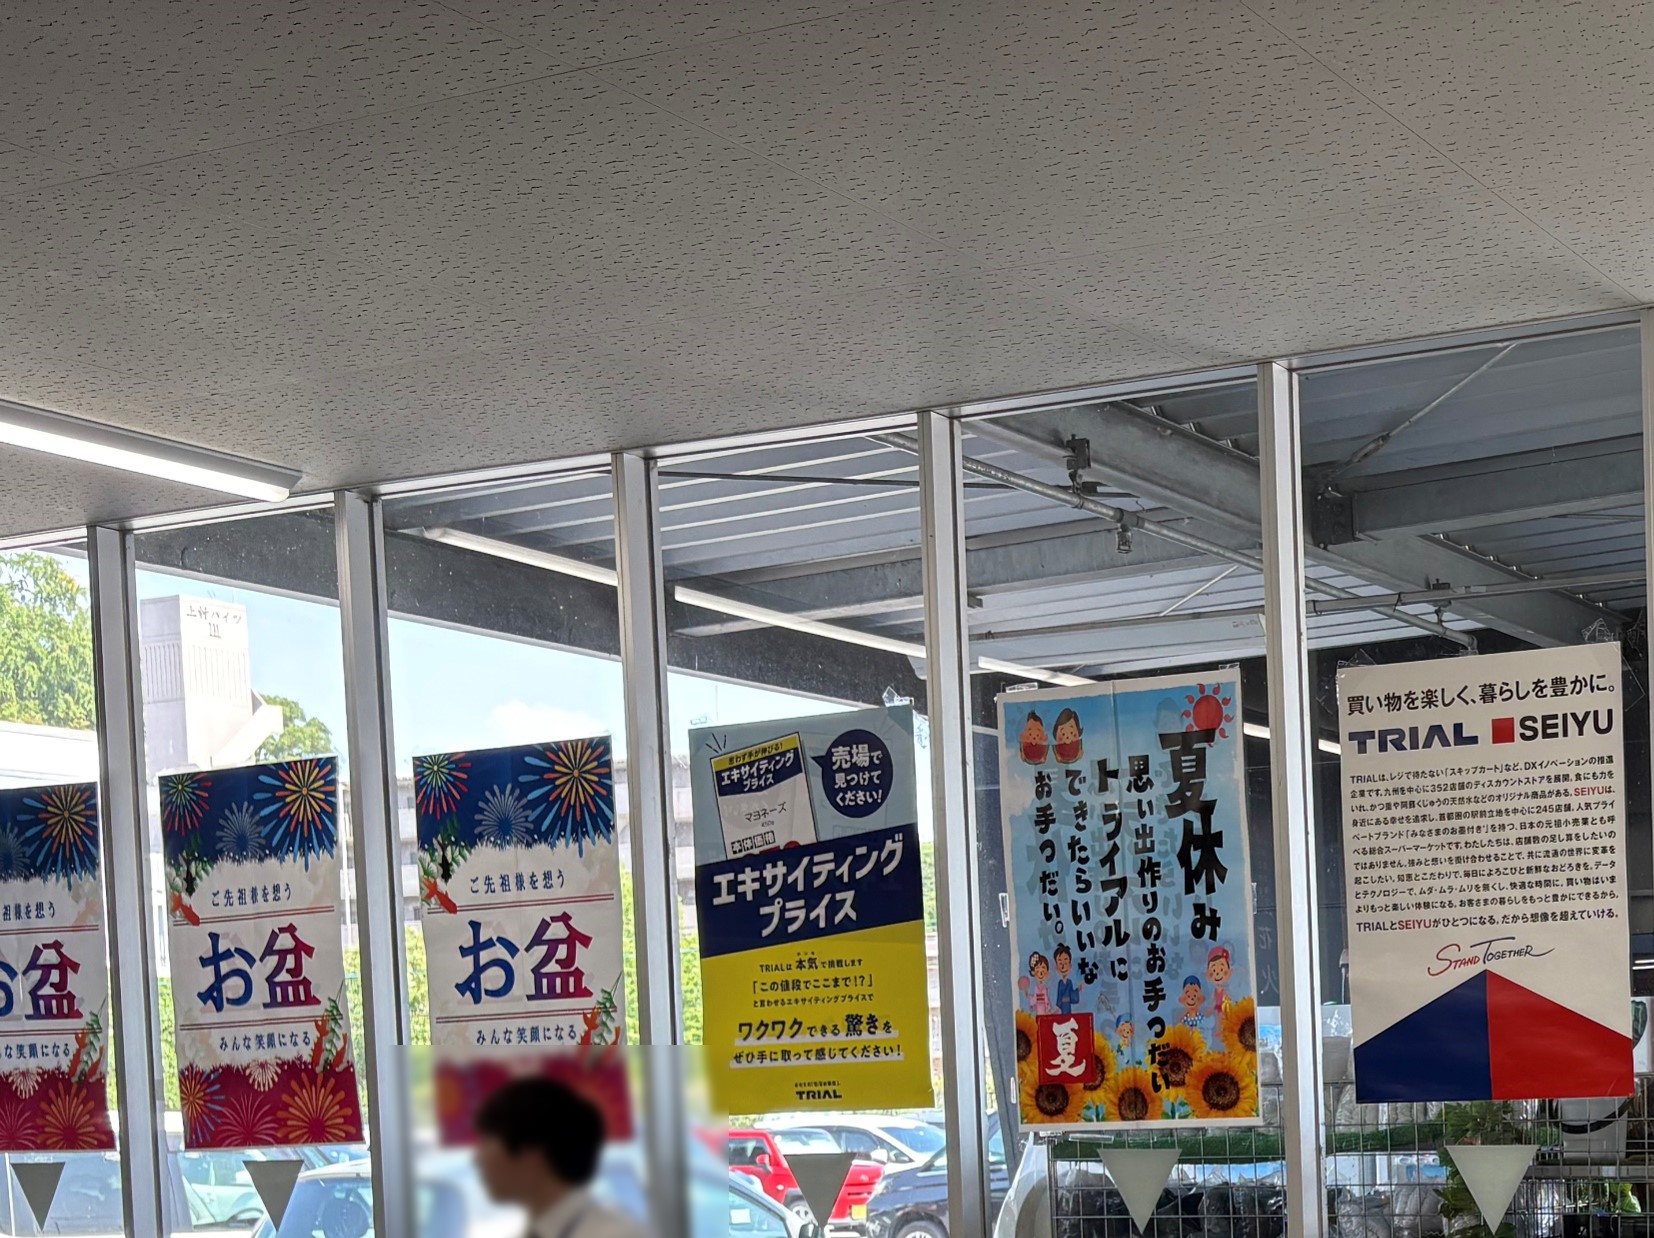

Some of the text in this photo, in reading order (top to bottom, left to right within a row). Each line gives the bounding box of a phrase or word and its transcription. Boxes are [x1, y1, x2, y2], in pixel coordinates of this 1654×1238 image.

[1347, 673, 1615, 715] 買い物を楽しく、暮らしを豊かに。
[1349, 708, 1613, 754] TRIAL SEIYU
[721, 751, 795, 785] エキサイティング
[831, 744, 883, 770] 売場で
[743, 774, 775, 792] プライス
[834, 770, 882, 789] 見つけて
[745, 802, 787, 822] マヨネーズ
[836, 789, 882, 807] ください!
[1158, 729, 1227, 942] 夏休み
[1034, 771, 1064, 935] お手つだい。
[470, 868, 566, 894] ご先祖様を想う
[712, 833, 904, 906] エキサイティング
[1066, 769, 1099, 984] できたらいいな
[1097, 759, 1130, 981] トライアルに
[211, 883, 292, 907] ご先祖様を想う
[759, 890, 857, 937] プライス
[1127, 754, 1171, 1094] 思い出作りのお手つだい
[197, 922, 322, 1013] お盆
[454, 911, 594, 1005] お盆
[476, 1025, 578, 1046] みんな笑顔になる
[738, 1013, 892, 1041] ワクワクできる驚きを
[0, 1043, 71, 1061] な笑顔になる
[219, 1033, 312, 1053] みんな笑顔になる
[733, 1045, 901, 1064] ぜひ手に取って感じてください!
[1045, 1017, 1086, 1077] 夏
[796, 1089, 842, 1100] TRIAL
